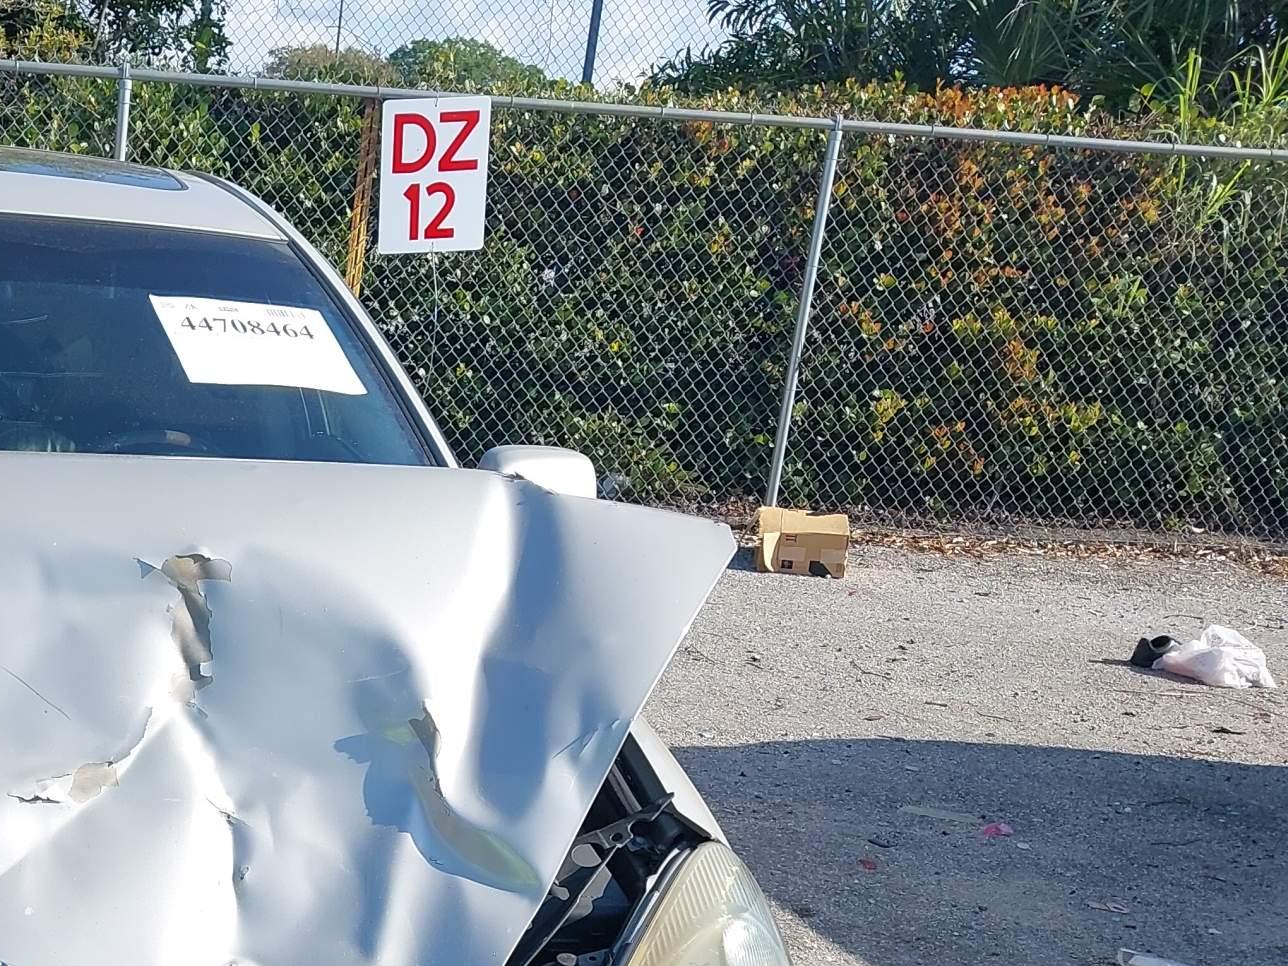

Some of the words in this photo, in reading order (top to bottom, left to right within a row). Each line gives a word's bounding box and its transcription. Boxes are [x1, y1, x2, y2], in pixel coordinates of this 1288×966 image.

[392, 110, 481, 174] DZ
[403, 181, 455, 241] 12
[180, 316, 315, 340] 44708464
